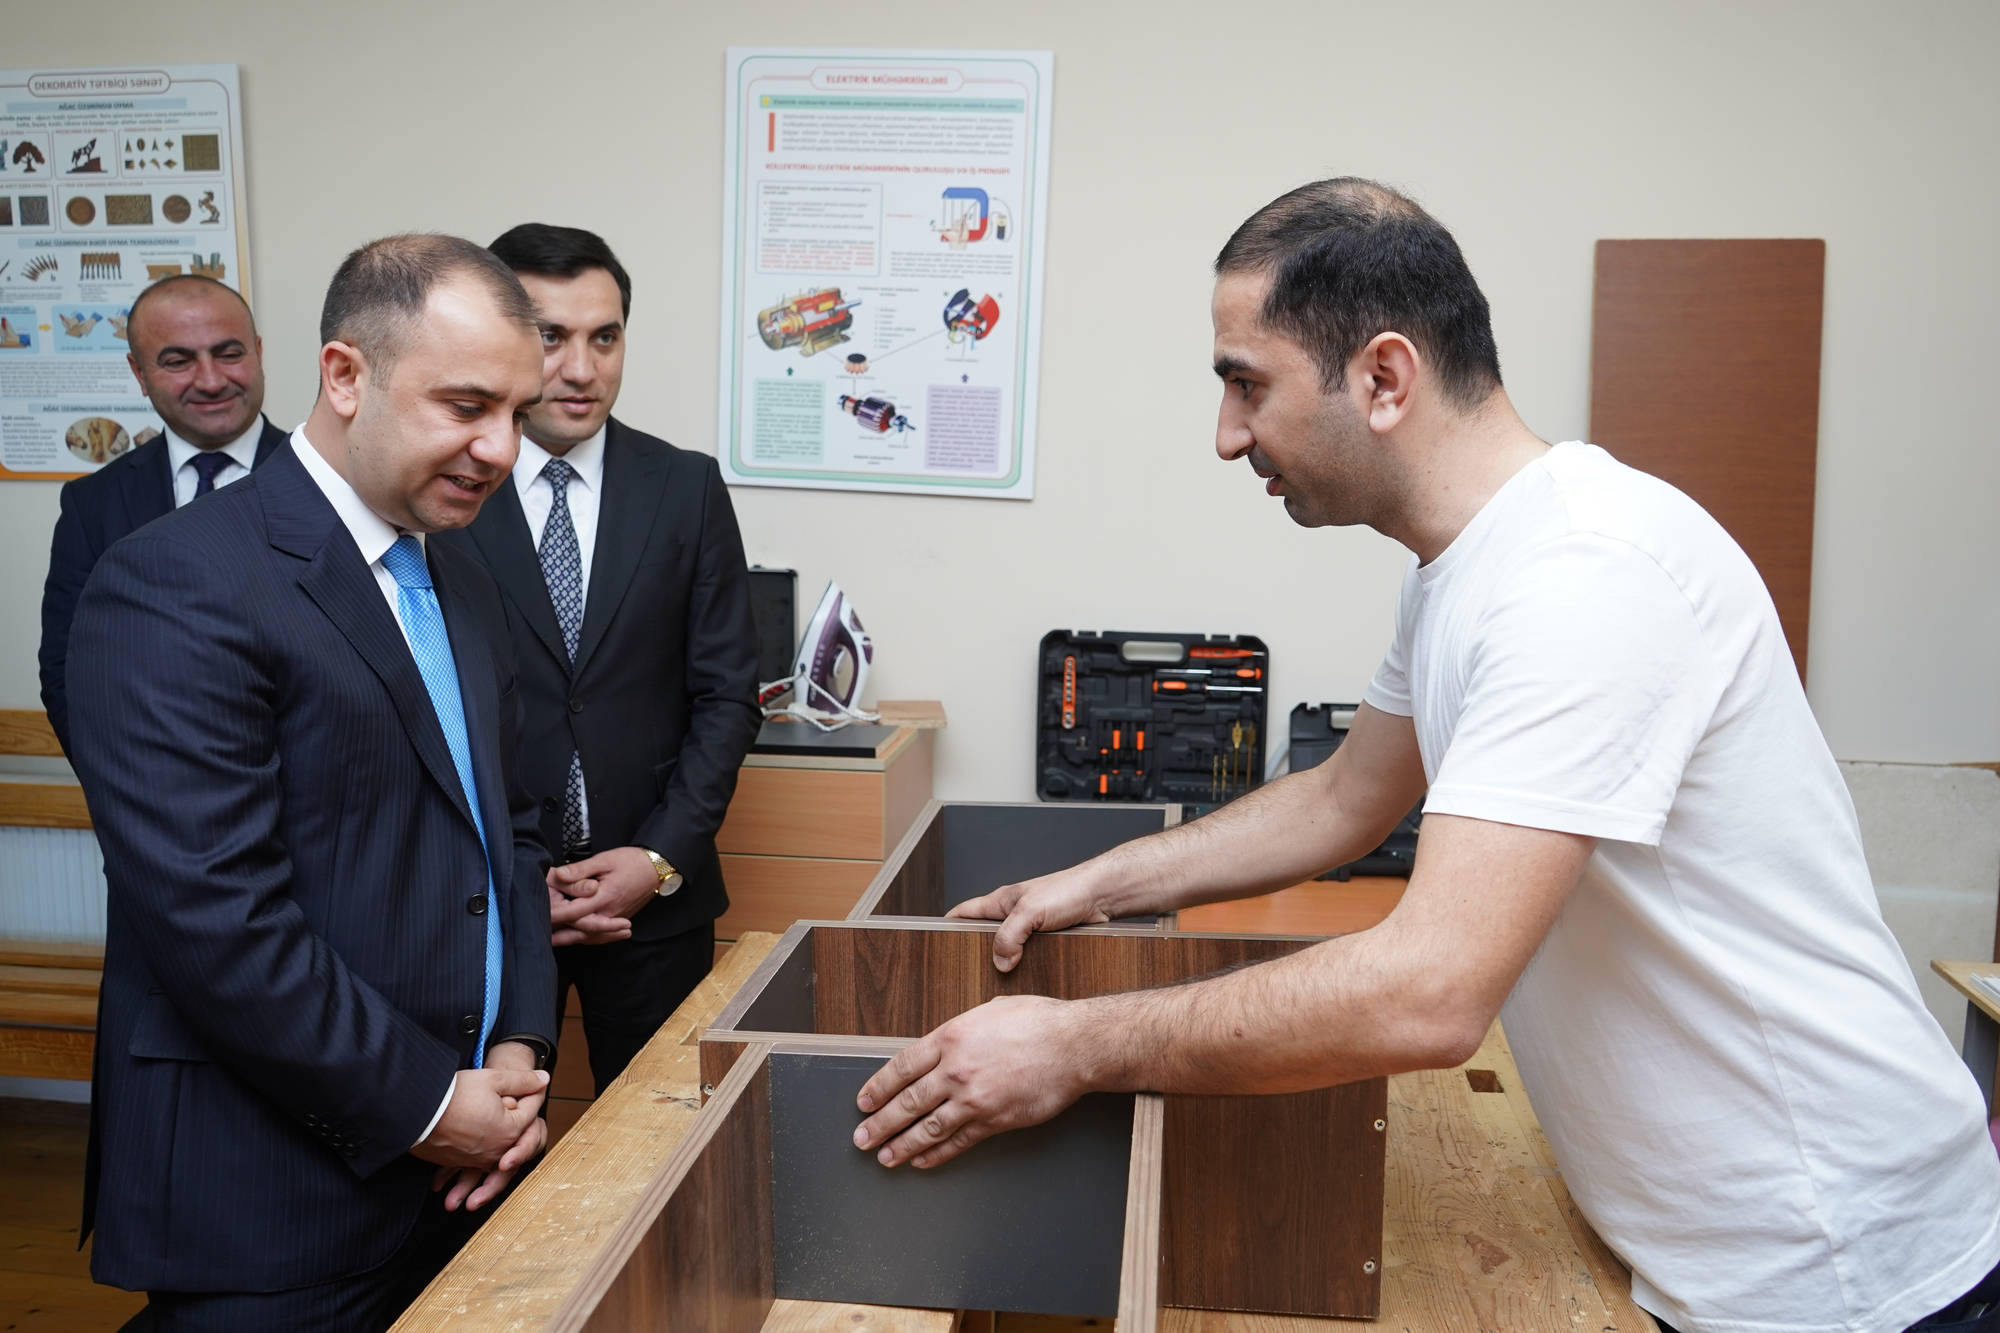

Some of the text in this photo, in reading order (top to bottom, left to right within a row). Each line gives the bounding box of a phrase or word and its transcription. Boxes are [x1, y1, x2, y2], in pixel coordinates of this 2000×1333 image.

[34, 77, 163, 90] DEKORATİV TƏTBİQİ SƏNƏT
[826, 74, 870, 84] ELEKTRİK
